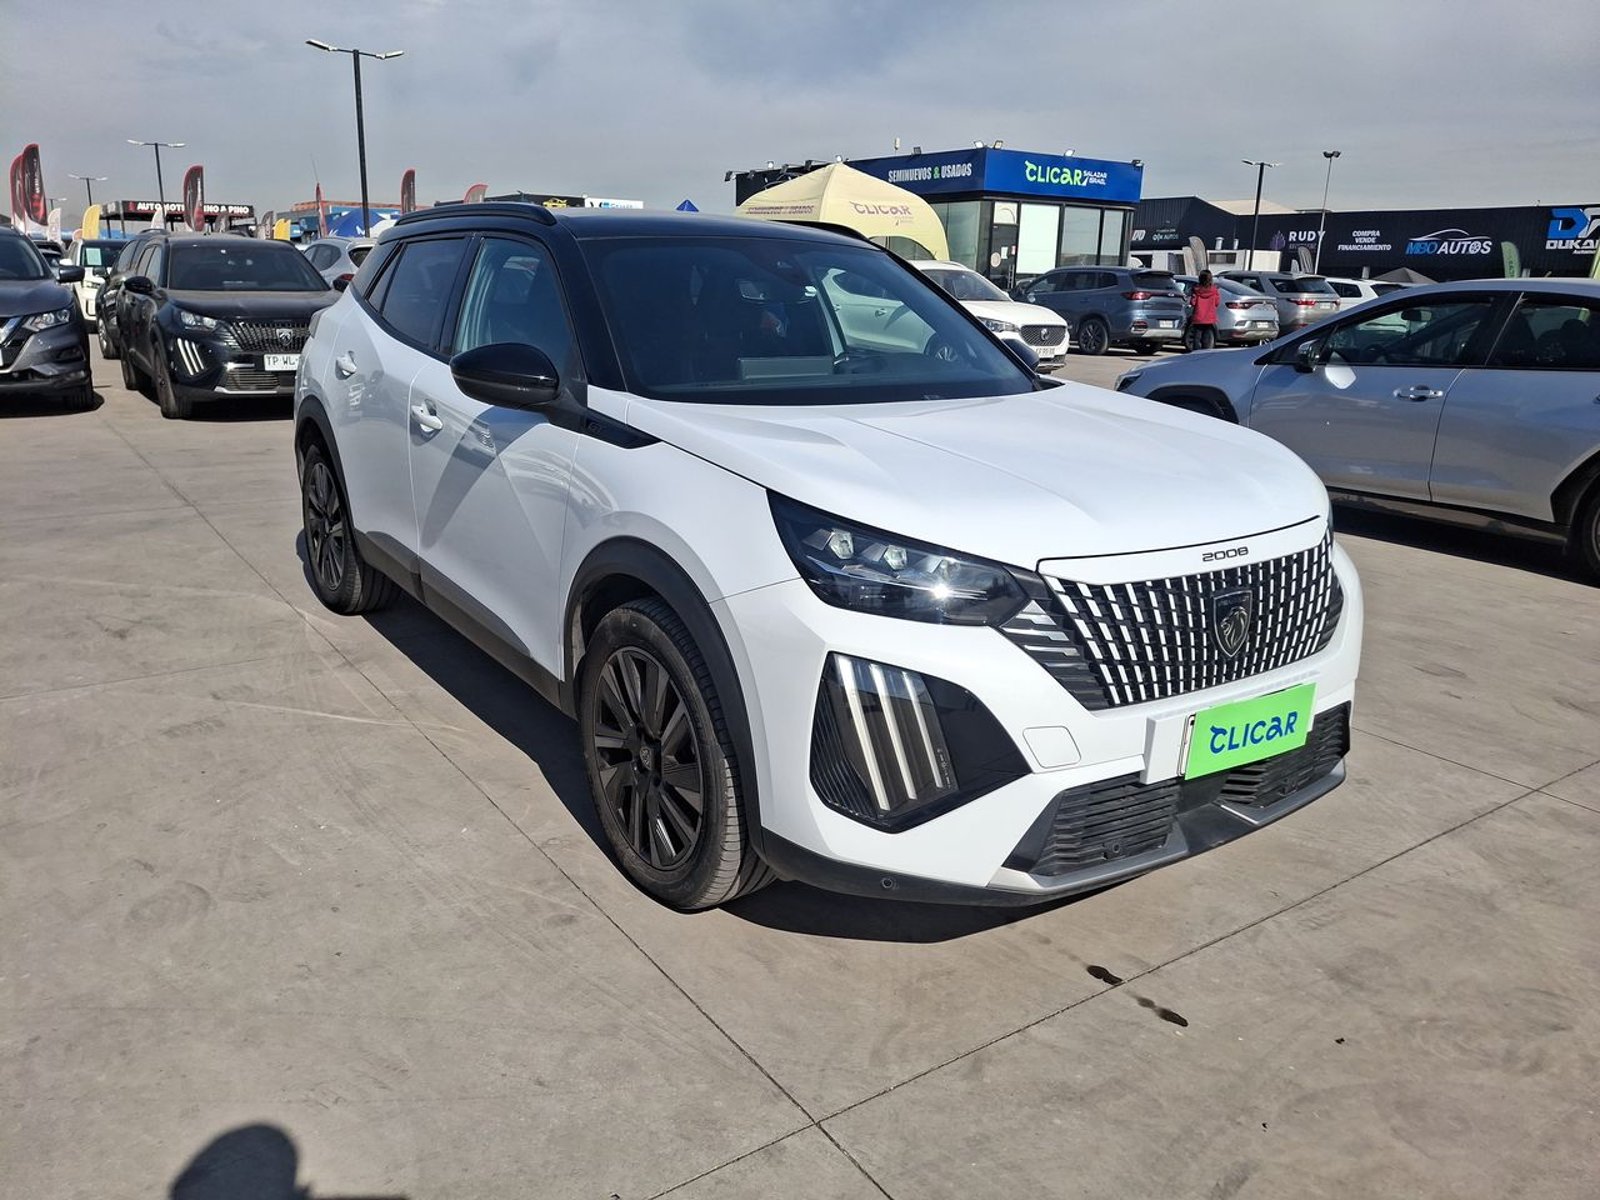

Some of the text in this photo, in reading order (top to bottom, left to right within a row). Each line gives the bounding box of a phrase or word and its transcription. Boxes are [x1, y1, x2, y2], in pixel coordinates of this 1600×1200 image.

[888, 163, 972, 182] SEMINUEVOS & USADOS
[1288, 230, 1326, 242] RUDY
[1437, 241, 1492, 255] AUTOS
[1545, 239, 1599, 250] DUKA
[1202, 547, 1249, 562] 2008
